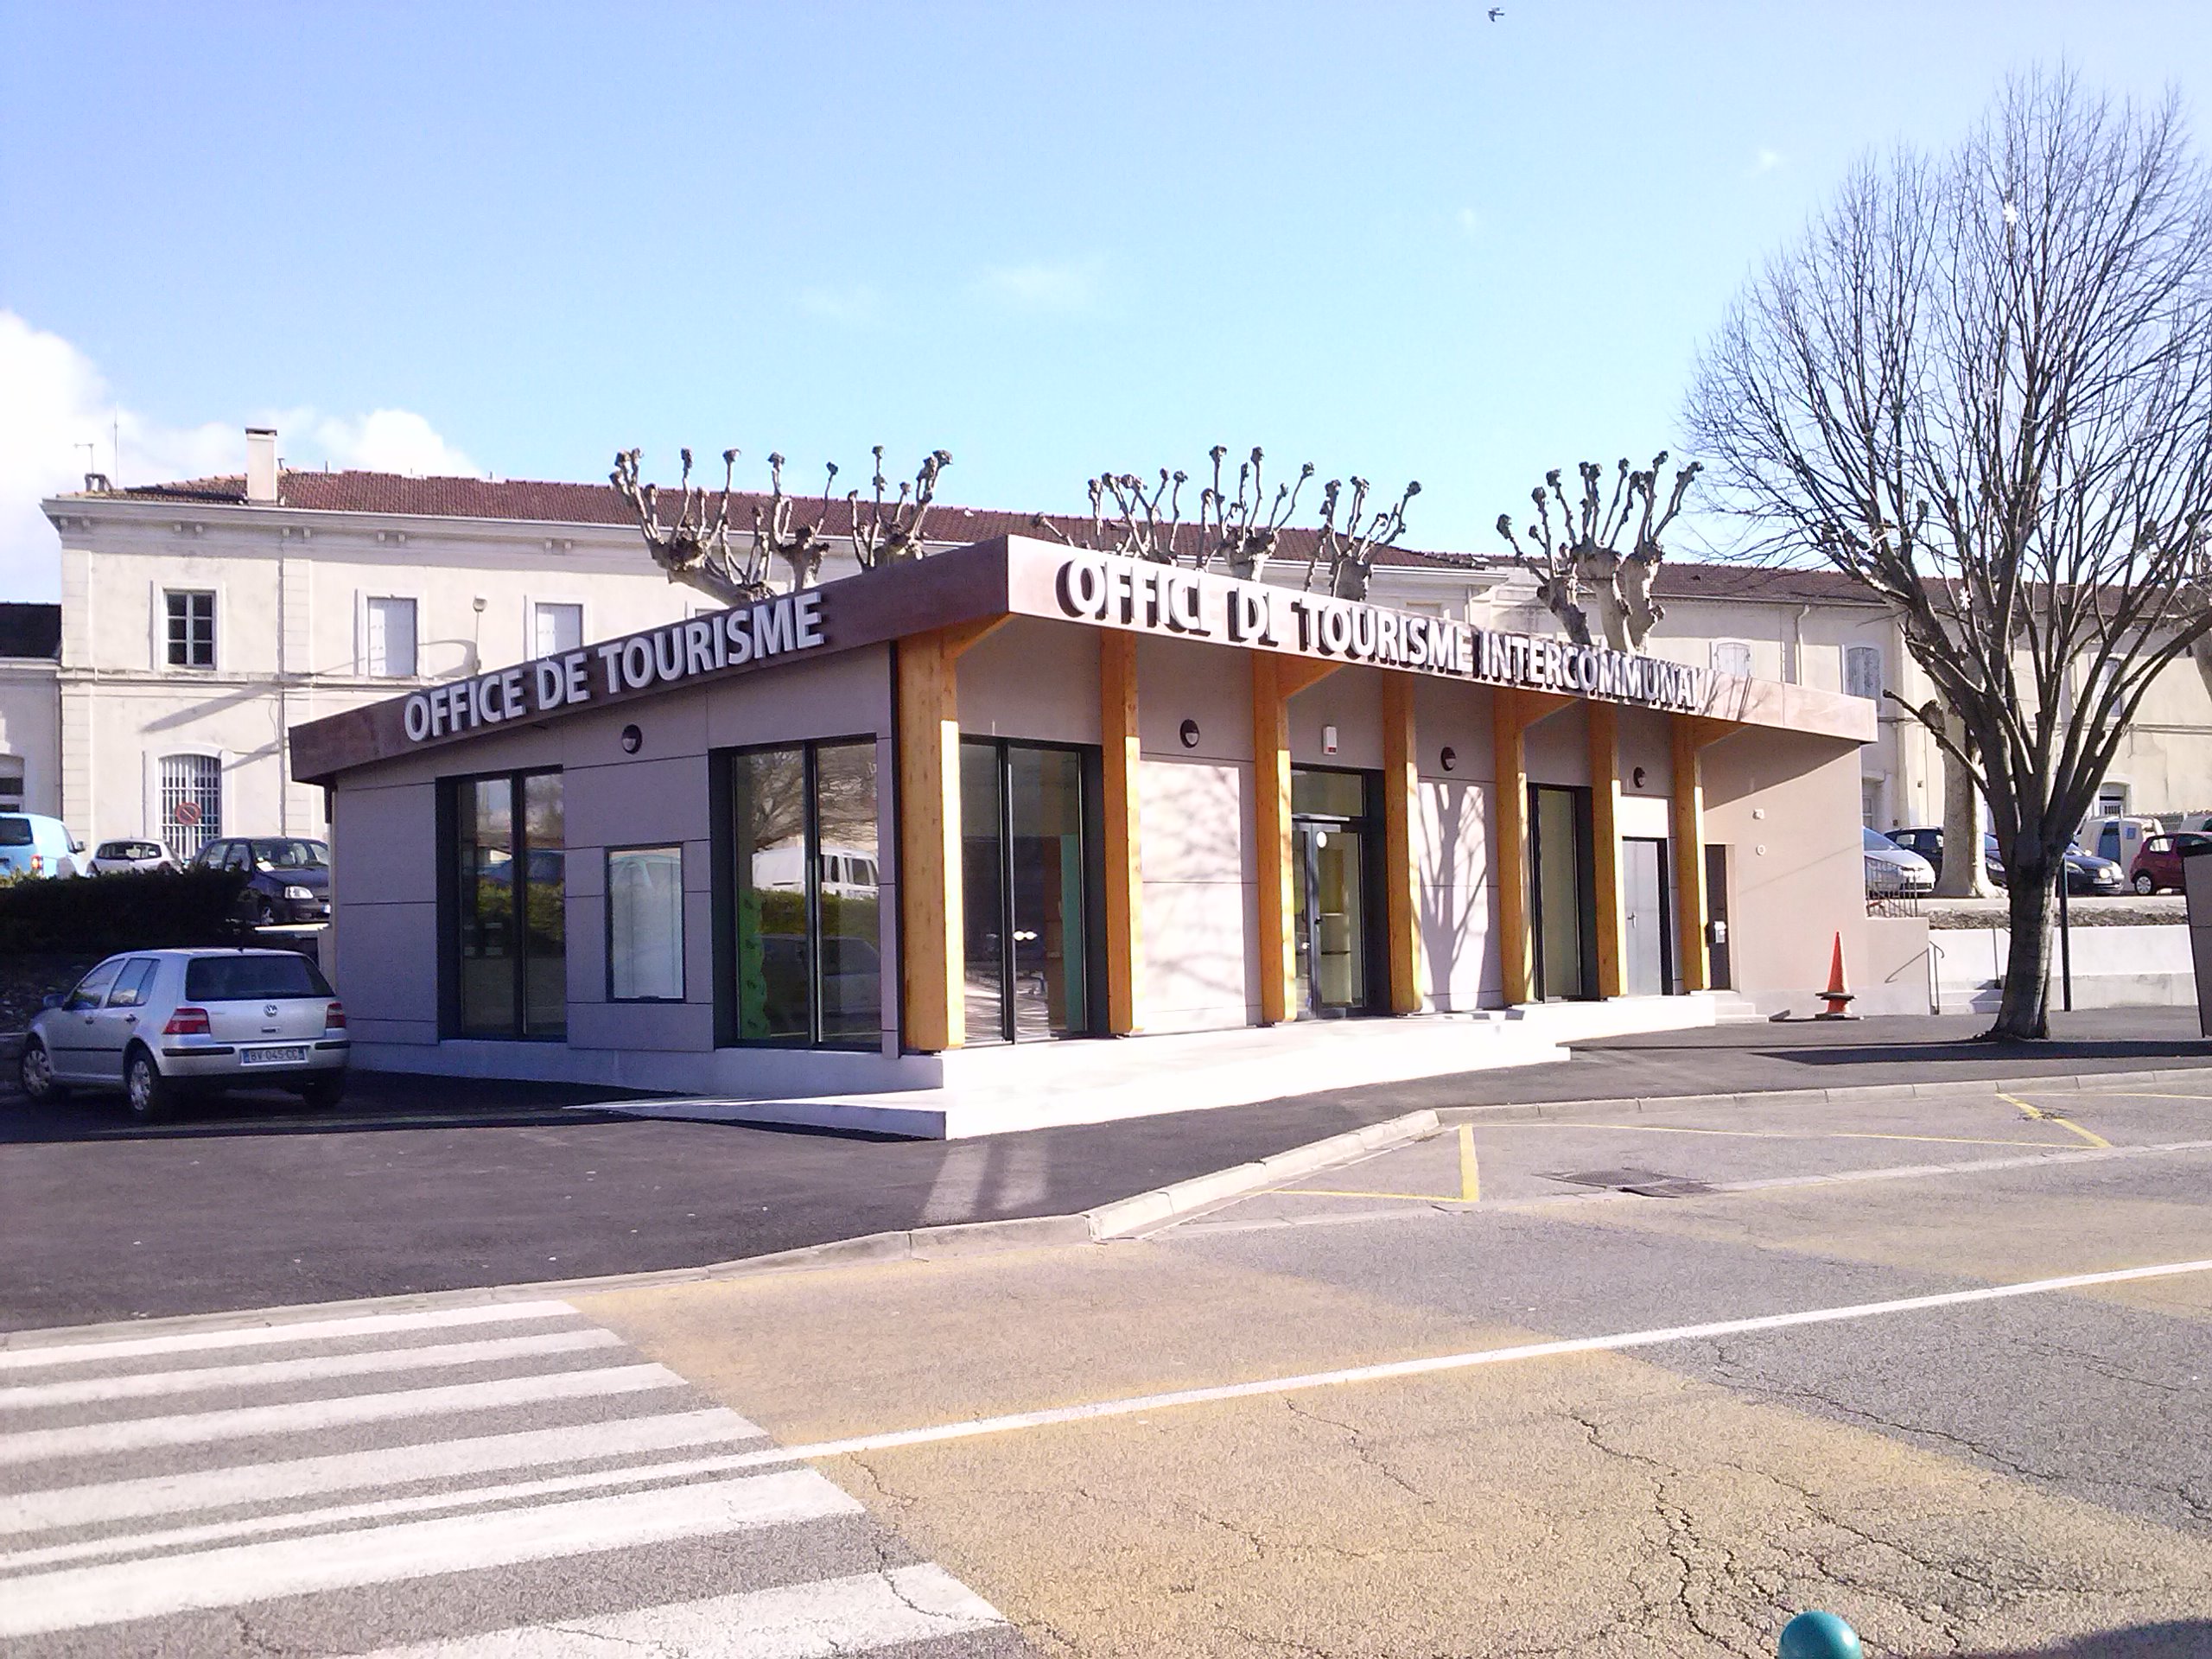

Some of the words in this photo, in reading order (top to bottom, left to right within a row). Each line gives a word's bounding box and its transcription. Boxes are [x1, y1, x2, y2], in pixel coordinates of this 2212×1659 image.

[404, 670, 526, 741] OFFICE
[536, 652, 591, 711] DE
[598, 591, 825, 694] TOURISME
[1065, 556, 1223, 635] OFFICE
[1234, 583, 1292, 645] DE
[1299, 598, 1472, 674] TOURISME
